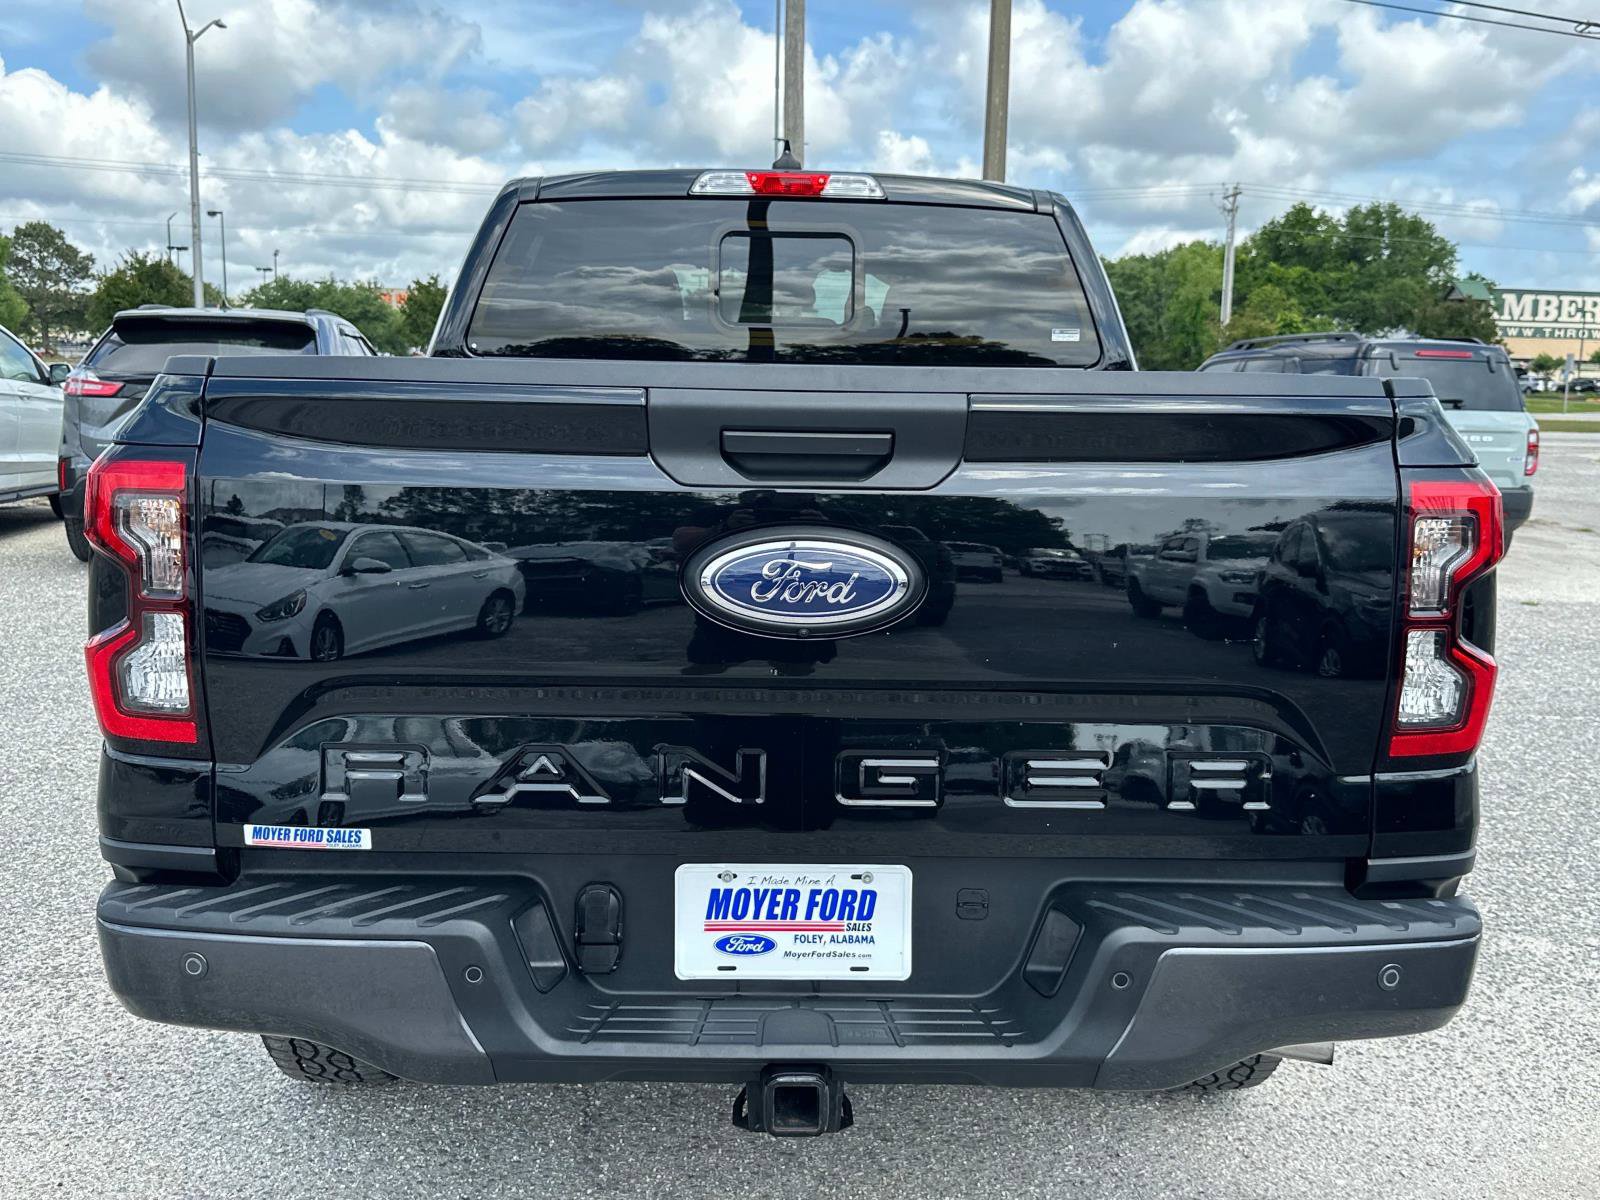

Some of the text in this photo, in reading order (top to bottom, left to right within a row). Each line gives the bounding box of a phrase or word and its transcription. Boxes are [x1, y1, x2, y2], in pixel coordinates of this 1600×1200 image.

[1490, 293, 1600, 323] MBER
[750, 558, 860, 604] Ford
[320, 742, 1273, 811] RANGER
[252, 826, 362, 844] MOYER FORD SALES
[747, 874, 836, 885] I Made Mine A
[705, 888, 878, 921] MOYER FORD
[845, 922, 872, 932] SALES
[725, 936, 766, 953] Ford
[794, 934, 876, 946] FOLEY, ALABAMA
